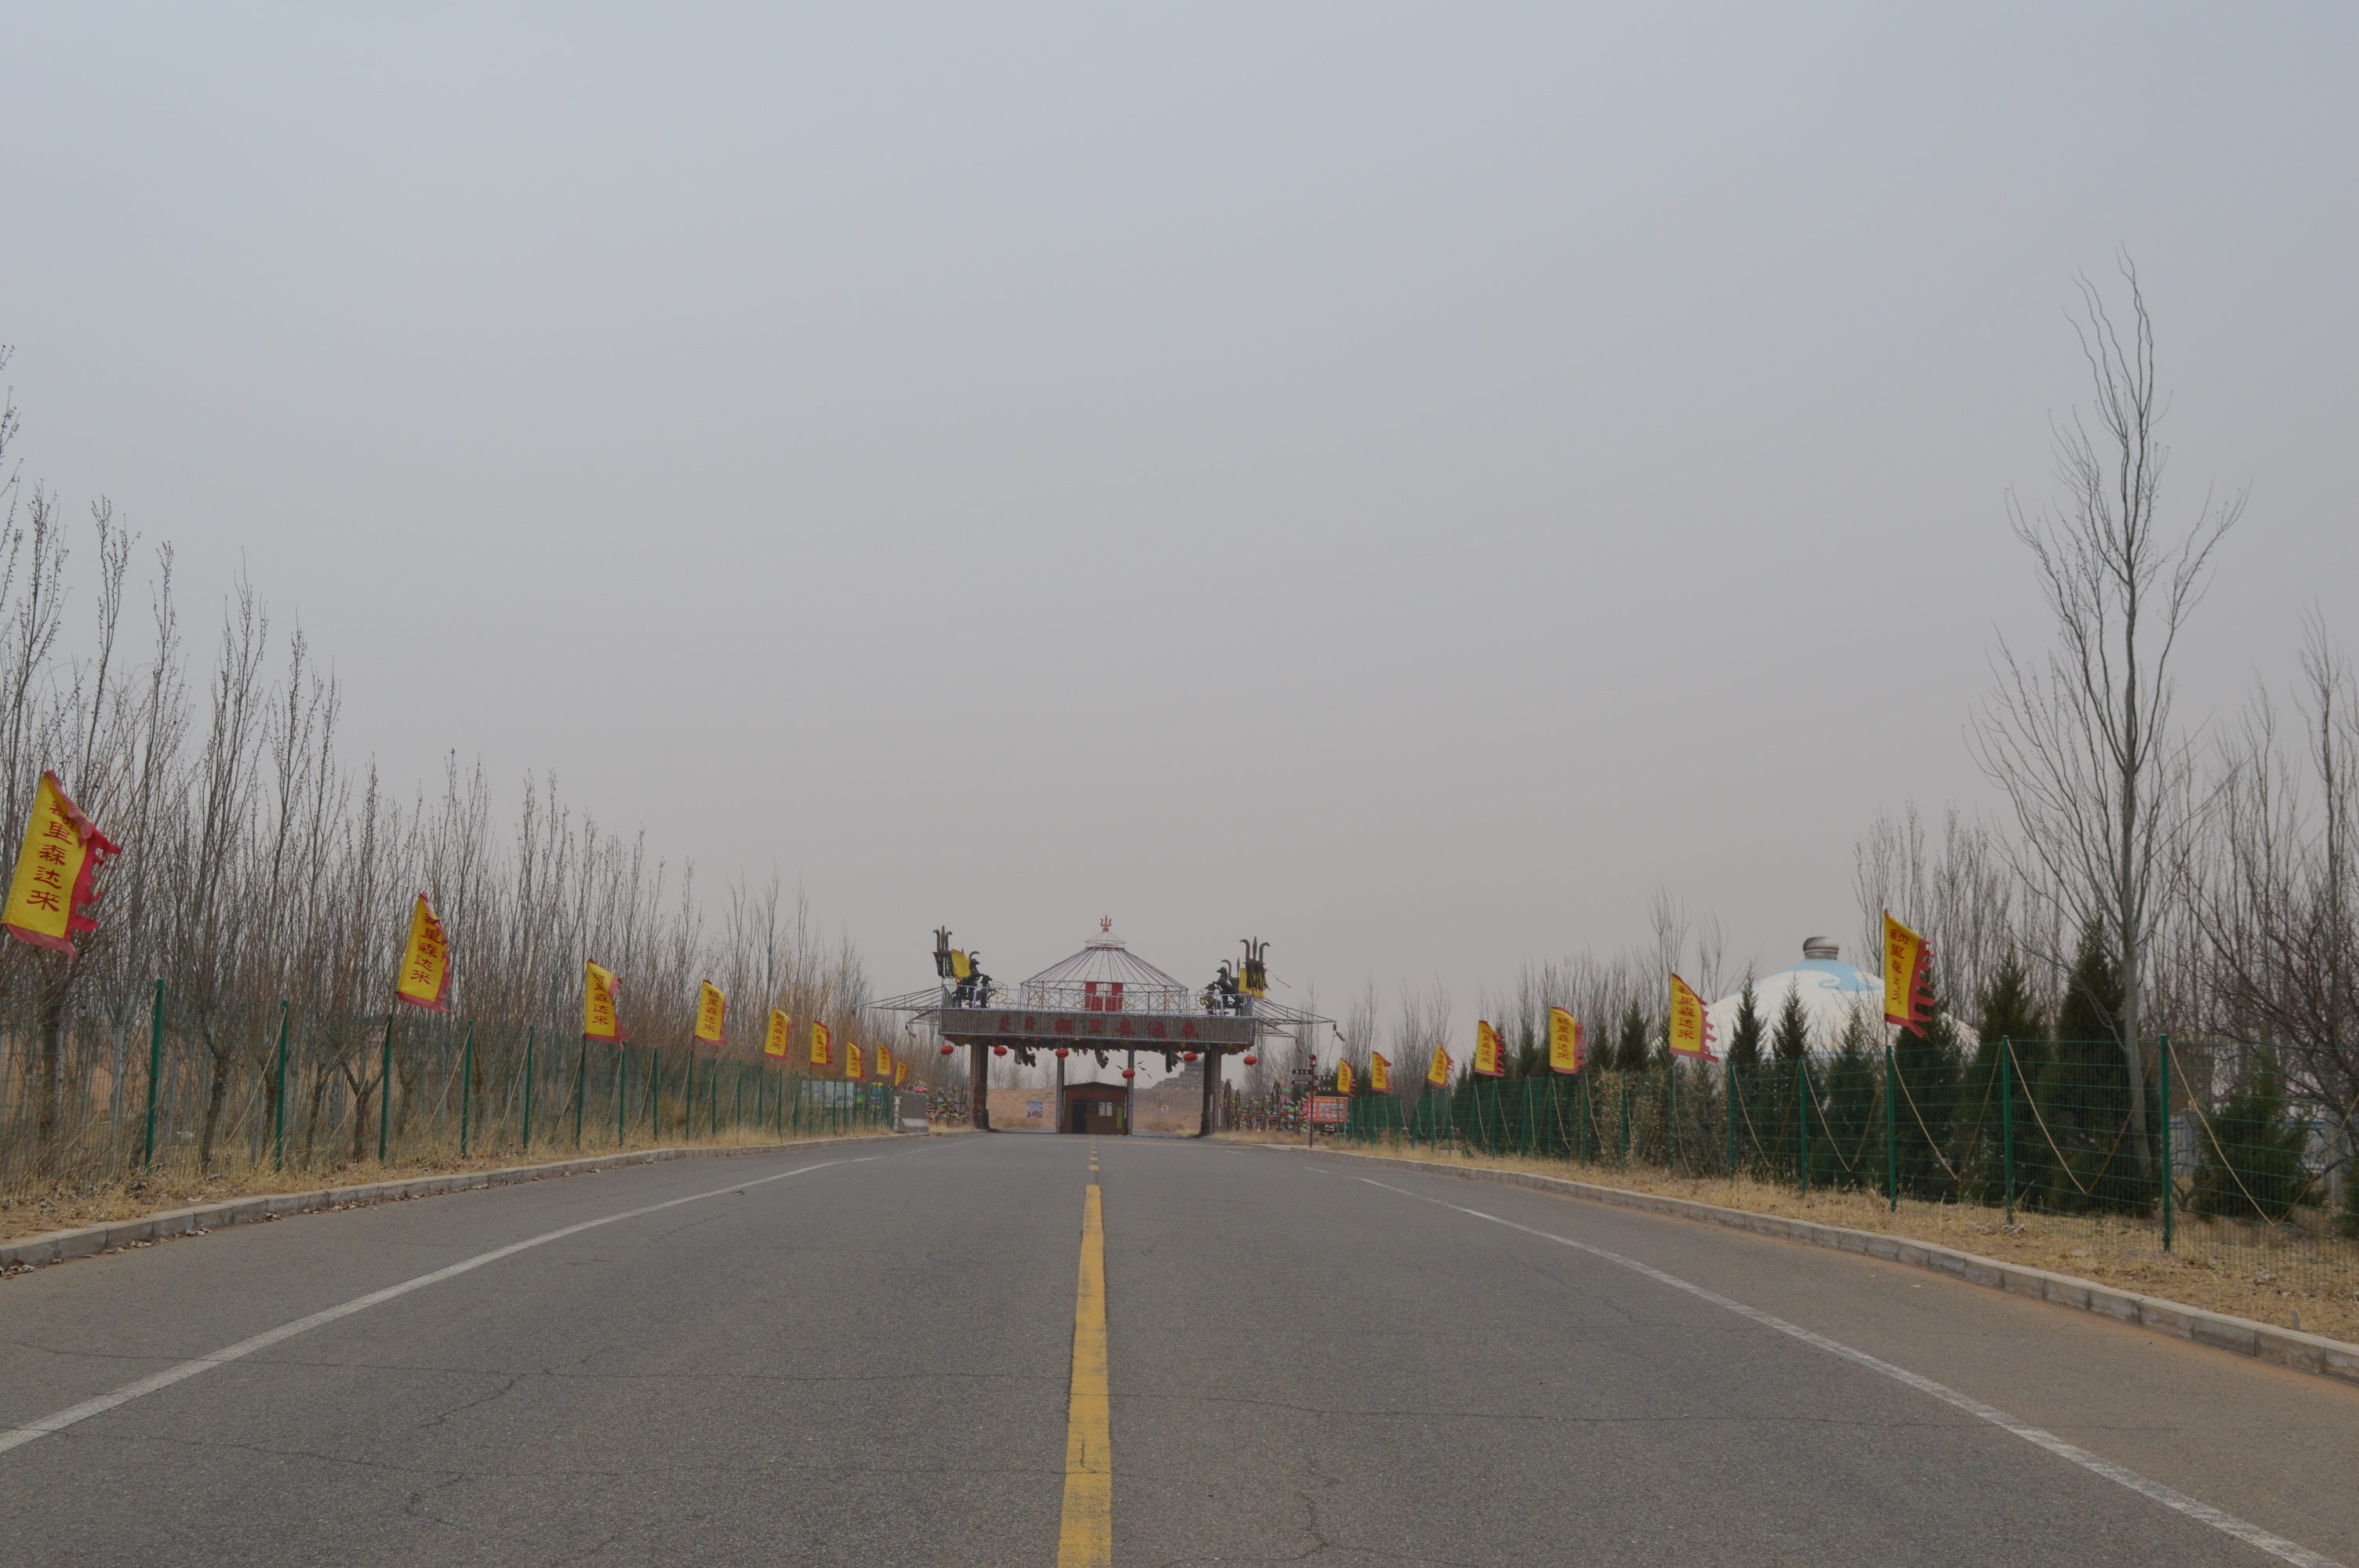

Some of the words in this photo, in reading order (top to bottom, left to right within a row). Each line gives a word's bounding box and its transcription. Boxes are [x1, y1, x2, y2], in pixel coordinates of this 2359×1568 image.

[1556, 1016, 1571, 1061] 额里森达来
